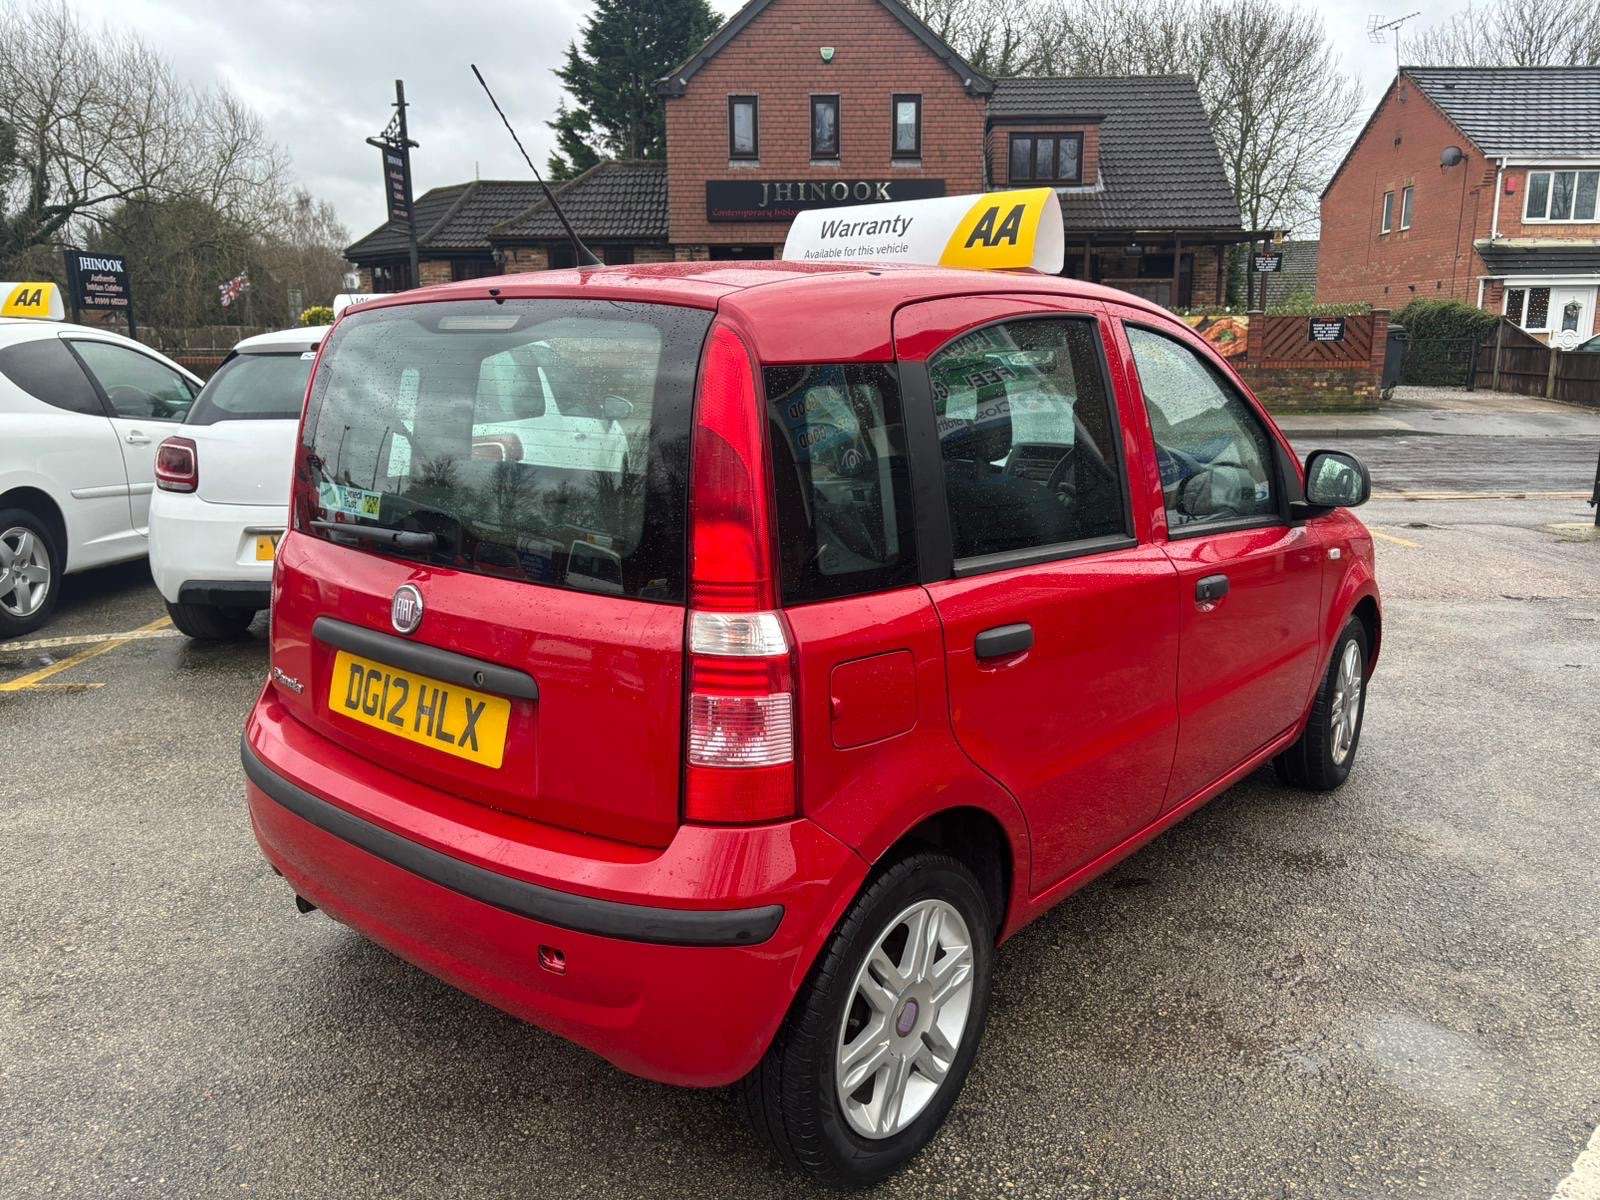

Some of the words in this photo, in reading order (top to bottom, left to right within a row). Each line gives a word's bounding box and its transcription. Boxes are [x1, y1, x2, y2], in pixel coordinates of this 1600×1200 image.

[759, 181, 893, 208] JHINOOK
[820, 214, 914, 240] Warranty
[964, 204, 1026, 248] AA
[804, 248, 842, 260] Available
[844, 246, 857, 257] for
[858, 244, 875, 256] this
[876, 242, 909, 254] vehicle
[79, 256, 124, 272] JHINOOK
[14, 288, 43, 307] AA
[397, 597, 416, 622] FIAT
[345, 662, 410, 728] DG12
[414, 685, 487, 753] HLX
